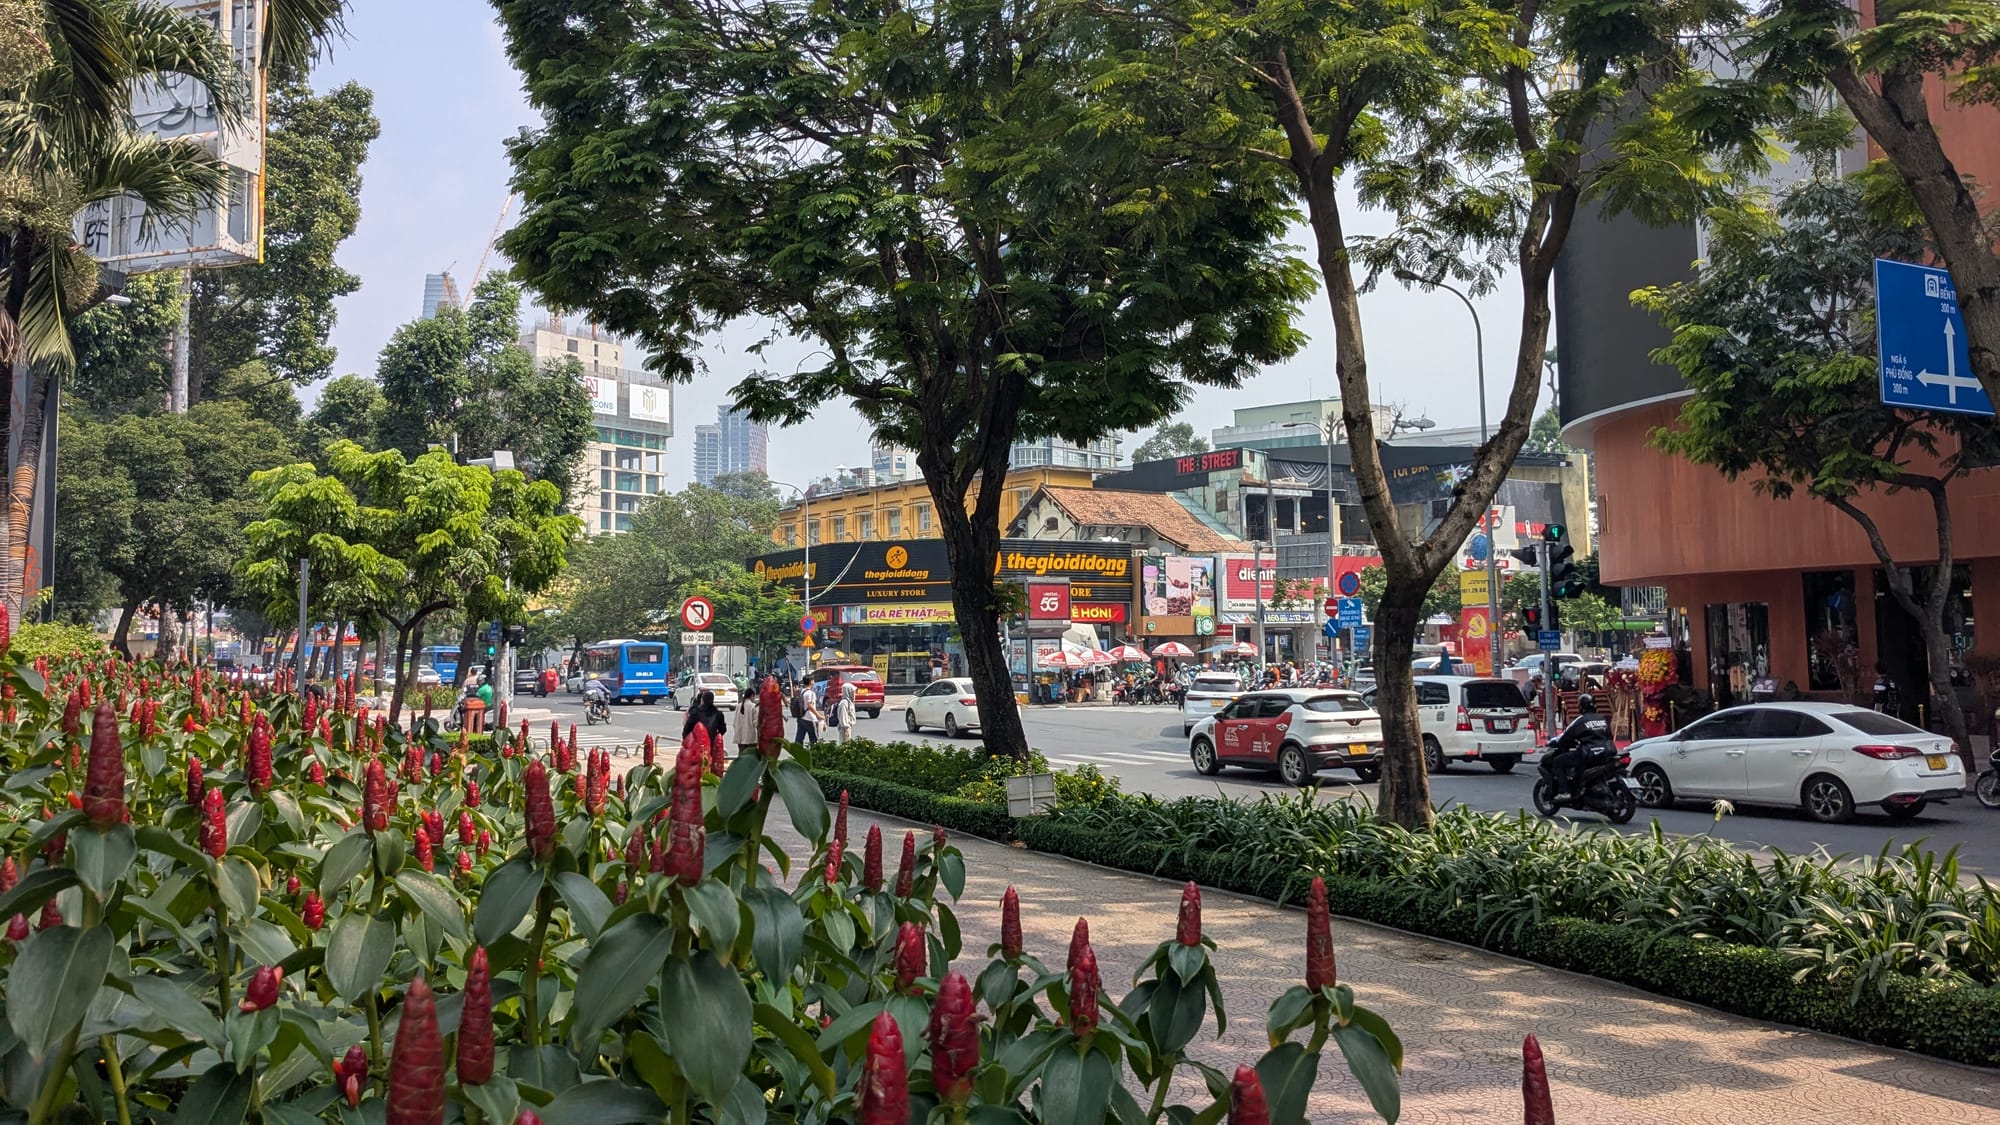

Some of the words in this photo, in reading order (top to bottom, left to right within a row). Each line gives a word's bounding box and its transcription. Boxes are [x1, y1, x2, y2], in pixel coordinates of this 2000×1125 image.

[1939, 276, 1947, 284] GA
[1940, 303, 1949, 313] 300
[1950, 306, 1956, 314] m
[1892, 383, 1902, 394] 300
[1903, 386, 1909, 394] m
[1176, 457, 1195, 473] THE
[1201, 450, 1238, 470] STREET
[1007, 552, 1127, 576] thegioididong
[766, 561, 817, 584] thegioididong
[864, 569, 929, 580] thegioididong
[866, 590, 899, 598] LUXURY
[901, 589, 926, 597] STORE
[1070, 587, 1092, 597] ORE
[1040, 597, 1059, 612] 5G
[868, 608, 887, 619] GIÁ
[889, 606, 904, 618] RẺ
[905, 606, 937, 620] THẬT!
[1071, 605, 1079, 618] Ẻ
[1081, 605, 1112, 618] HƠN!
